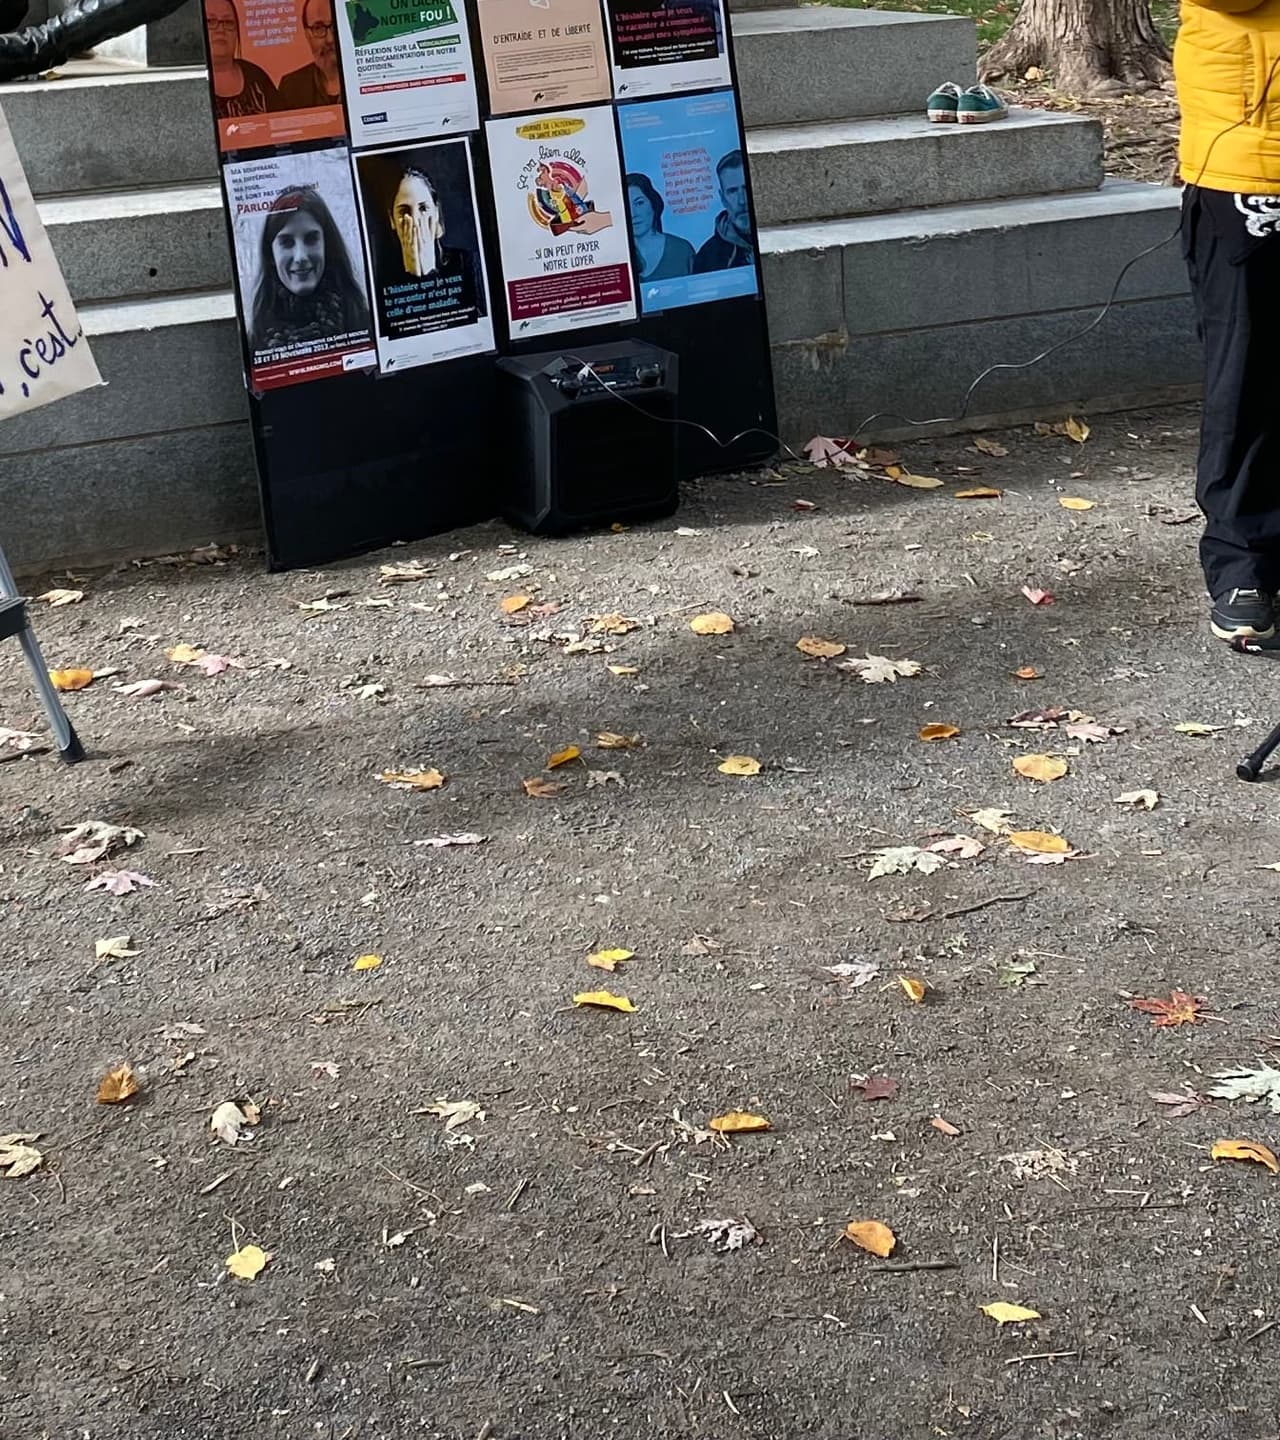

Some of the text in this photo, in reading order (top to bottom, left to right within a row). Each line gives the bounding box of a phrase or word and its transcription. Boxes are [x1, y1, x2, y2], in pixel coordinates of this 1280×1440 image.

[380, 13, 417, 27] NOTRE
[420, 9, 443, 22] FOU
[538, 29, 547, 39] ET
[551, 27, 561, 38] DE
[355, 46, 392, 57] RÉFLEXION
[393, 44, 407, 53] SUR
[409, 43, 418, 51] LA
[365, 50, 426, 64] MÉDICAMENTATION
[427, 49, 435, 57] DE
[436, 47, 457, 56] NOTRE
[539, 145, 561, 160] bien
[544, 247, 554, 259] ON
[555, 244, 574, 257] PEUT
[576, 240, 600, 253] PAYER
[543, 255, 594, 272] NOTRE LOYER
[383, 275, 462, 295] L'histoire que je veux
[394, 292, 426, 305] raconter
[428, 289, 446, 298] n'est
[448, 287, 462, 296] pas
[387, 308, 404, 318] celle
[405, 304, 427, 314] d'une
